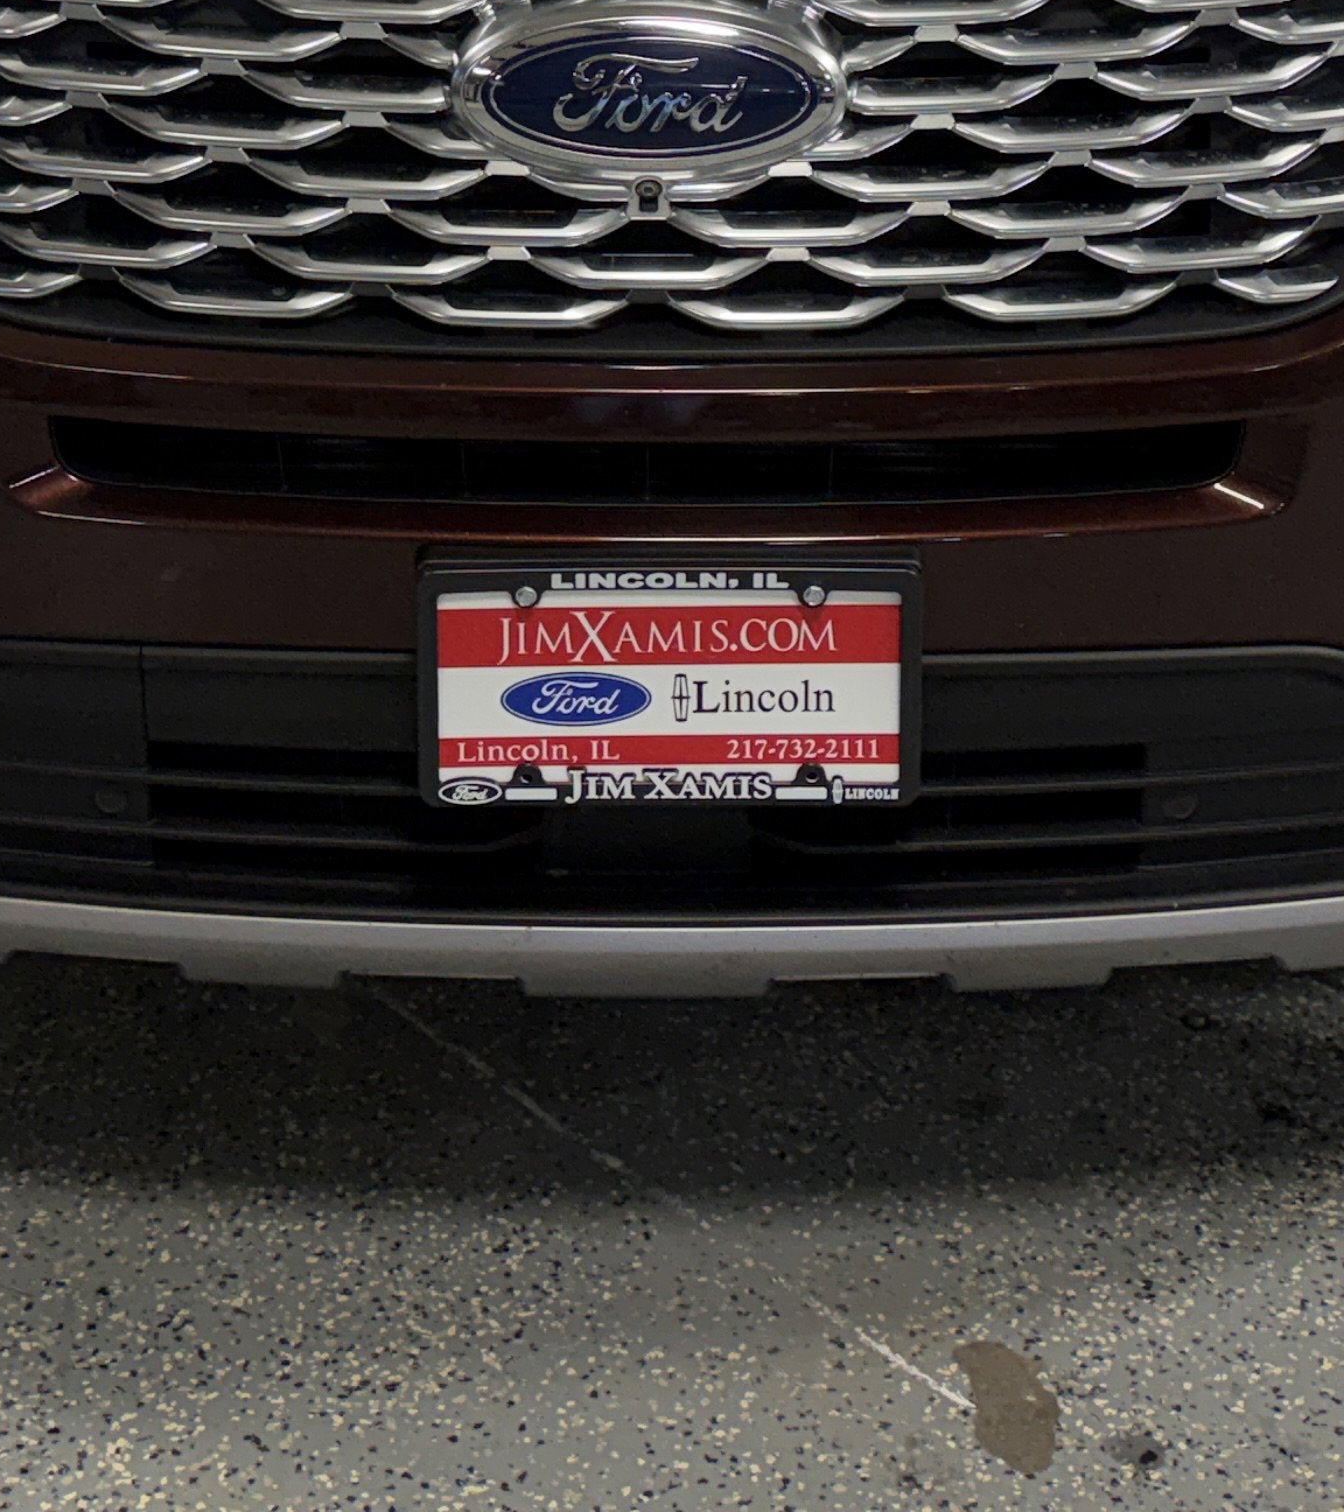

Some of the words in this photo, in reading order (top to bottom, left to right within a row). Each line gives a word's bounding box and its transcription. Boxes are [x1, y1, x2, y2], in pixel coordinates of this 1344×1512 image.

[554, 54, 749, 132] Ford
[551, 572, 739, 589] LINCOLN,
[753, 572, 789, 588] IL
[532, 680, 619, 715] Ford
[693, 680, 835, 713] Lincoln
[458, 740, 578, 763] Lincoln,
[591, 740, 620, 761] IL
[727, 739, 879, 759] 217-732-2111
[452, 785, 488, 801] Ford
[564, 770, 636, 805] JIM
[643, 770, 772, 801] XAMIS
[845, 788, 899, 800] LINCOLN
